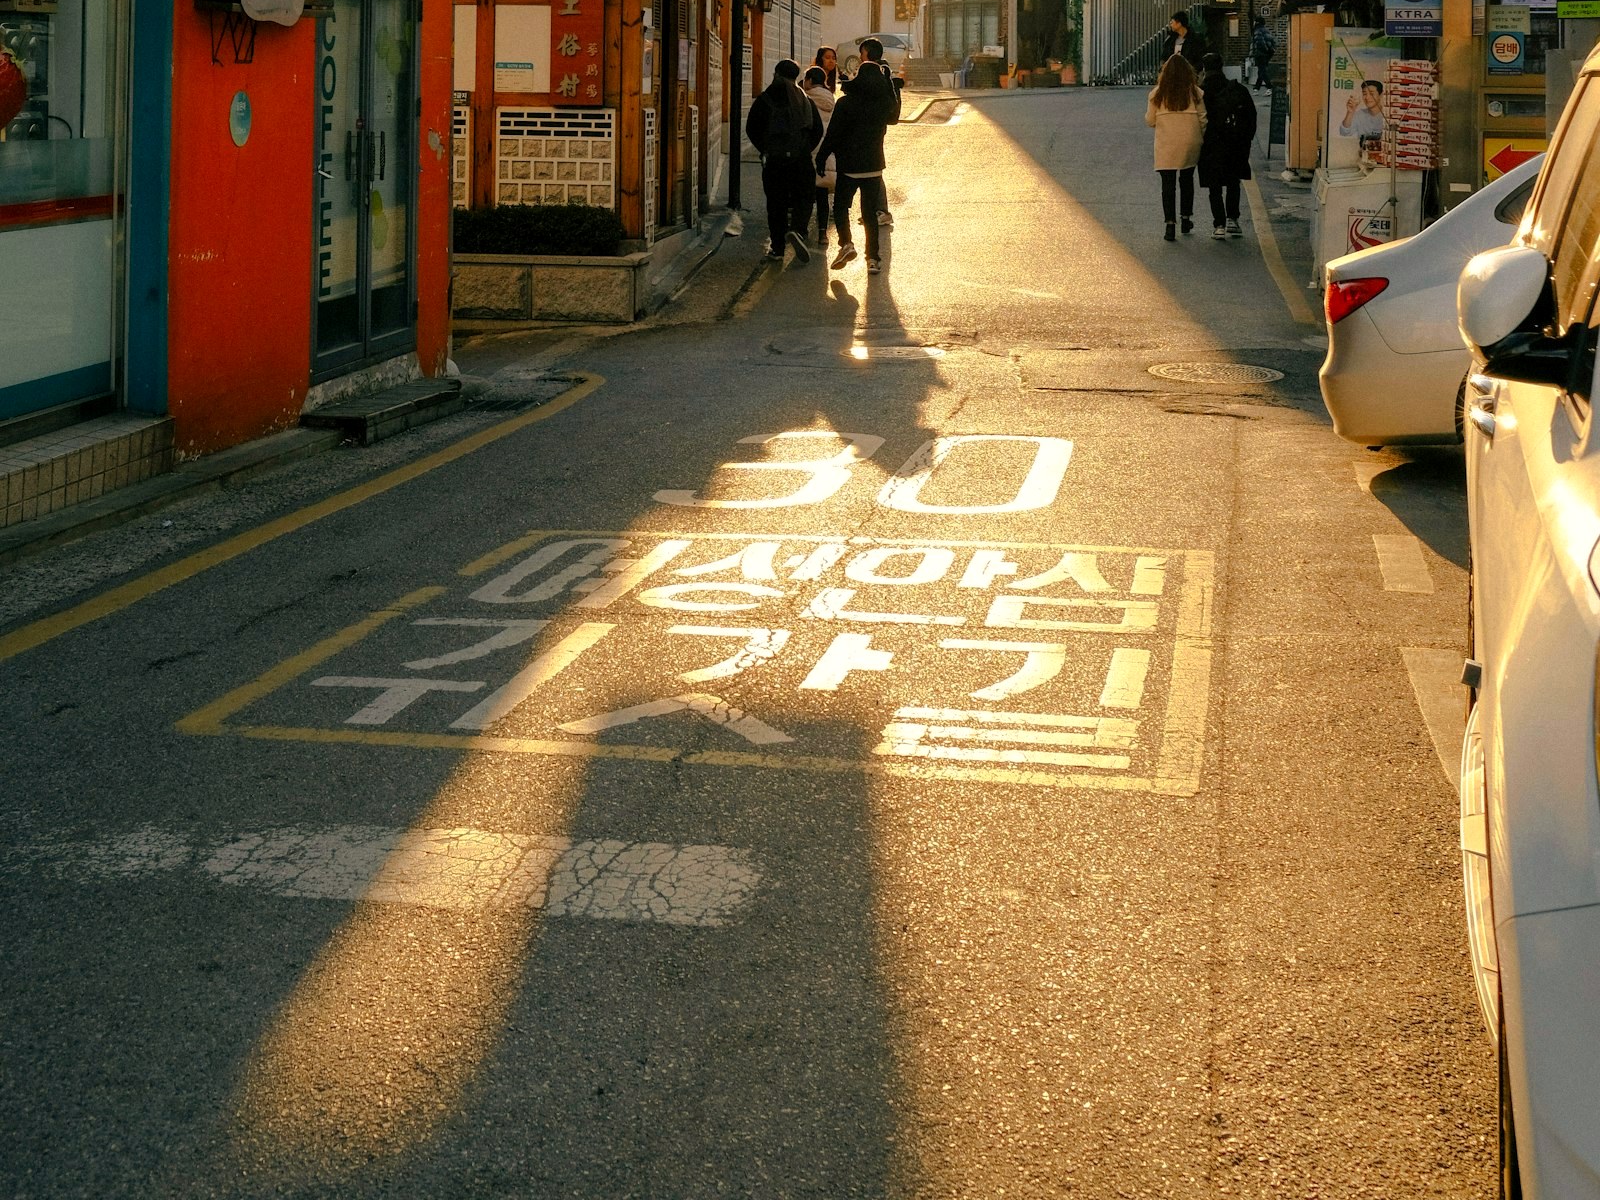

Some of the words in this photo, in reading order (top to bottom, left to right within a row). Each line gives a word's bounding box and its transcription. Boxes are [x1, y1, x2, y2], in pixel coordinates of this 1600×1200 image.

[1394, 10, 1433, 19] KTRA
[1335, 56, 1349, 71] 참
[1494, 42, 1518, 54] 담배
[1333, 79, 1354, 90] 이슬
[318, 8, 337, 297] COFFEE
[652, 431, 1074, 514] 30
[468, 538, 1167, 634] 여성안심
[311, 620, 1146, 769] 귀갓길
